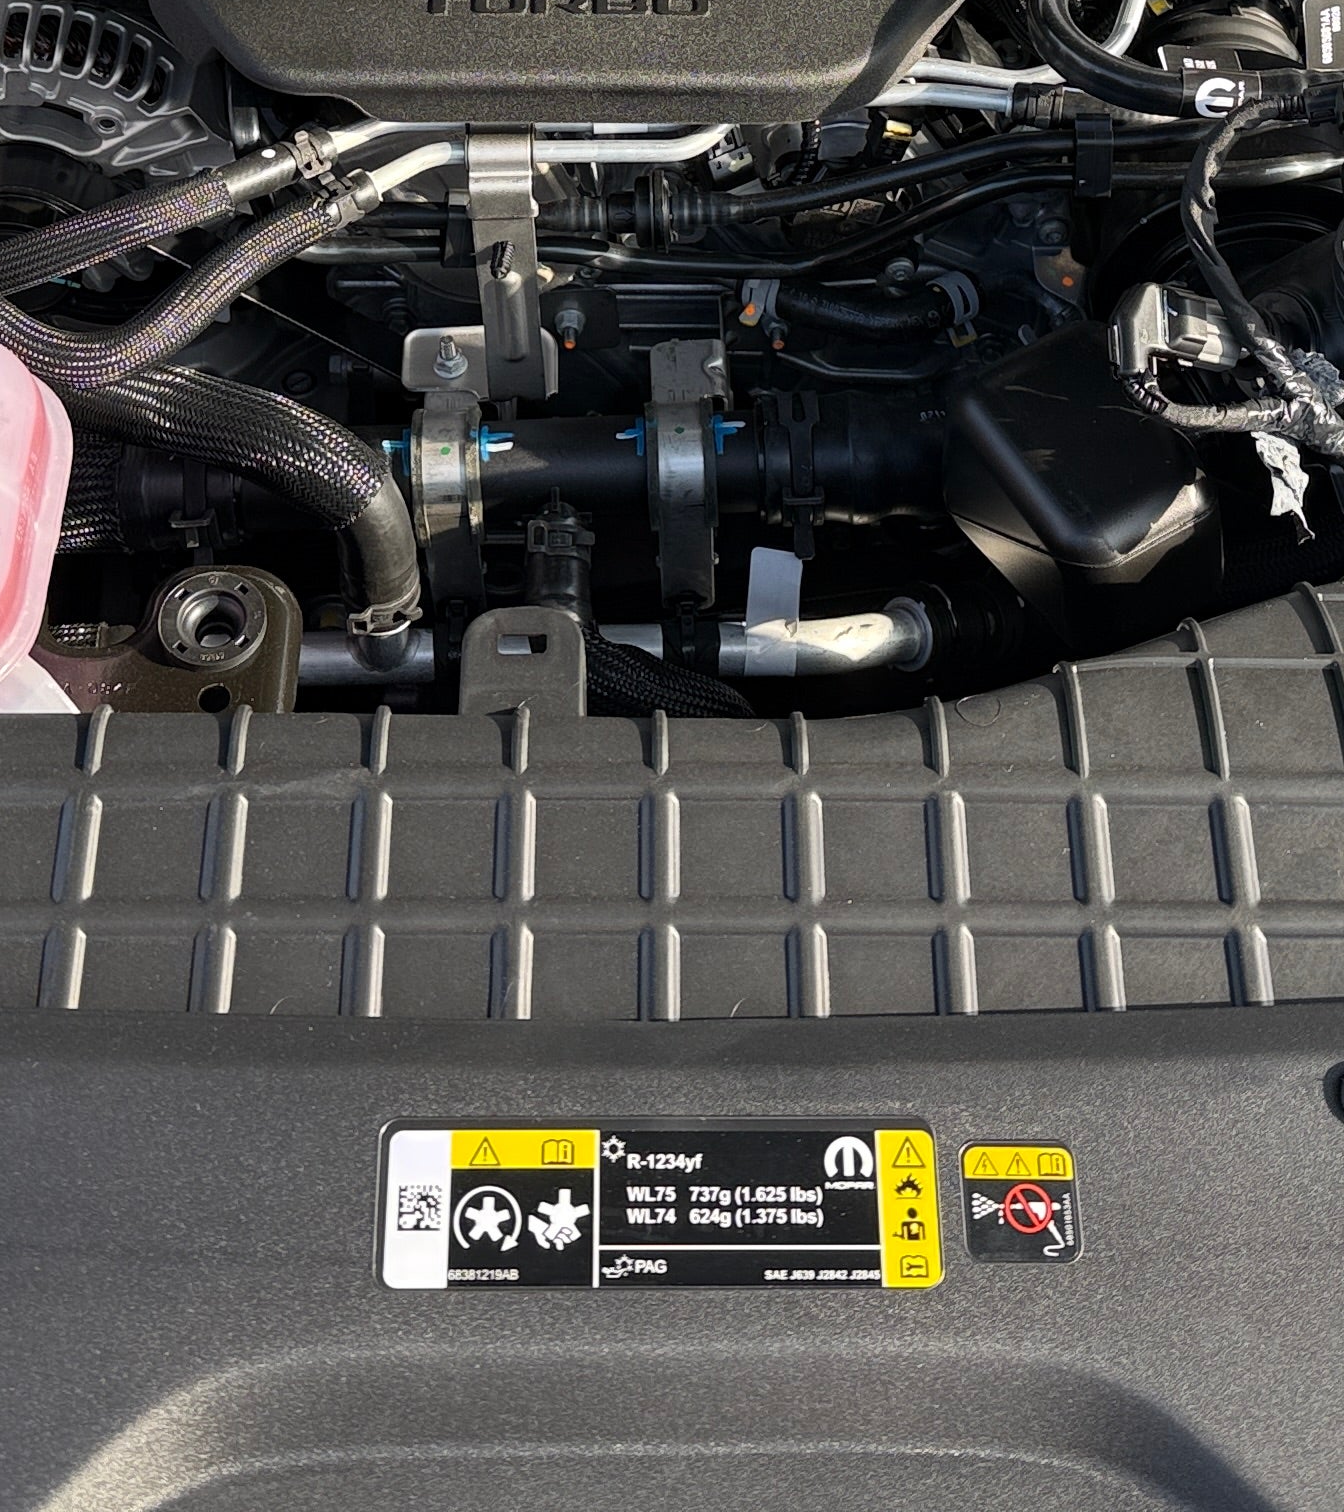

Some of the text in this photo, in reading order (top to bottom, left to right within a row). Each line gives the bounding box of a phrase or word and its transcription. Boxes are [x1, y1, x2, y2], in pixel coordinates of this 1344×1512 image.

[627, 1153, 704, 1173] R-1234yf
[626, 1186, 824, 1206] WL75 737g (1.625 lbs)
[626, 1208, 824, 1228] WL74 624g (1.375 lbs)
[634, 1259, 668, 1274] PAG
[764, 1269, 789, 1281] SAE
